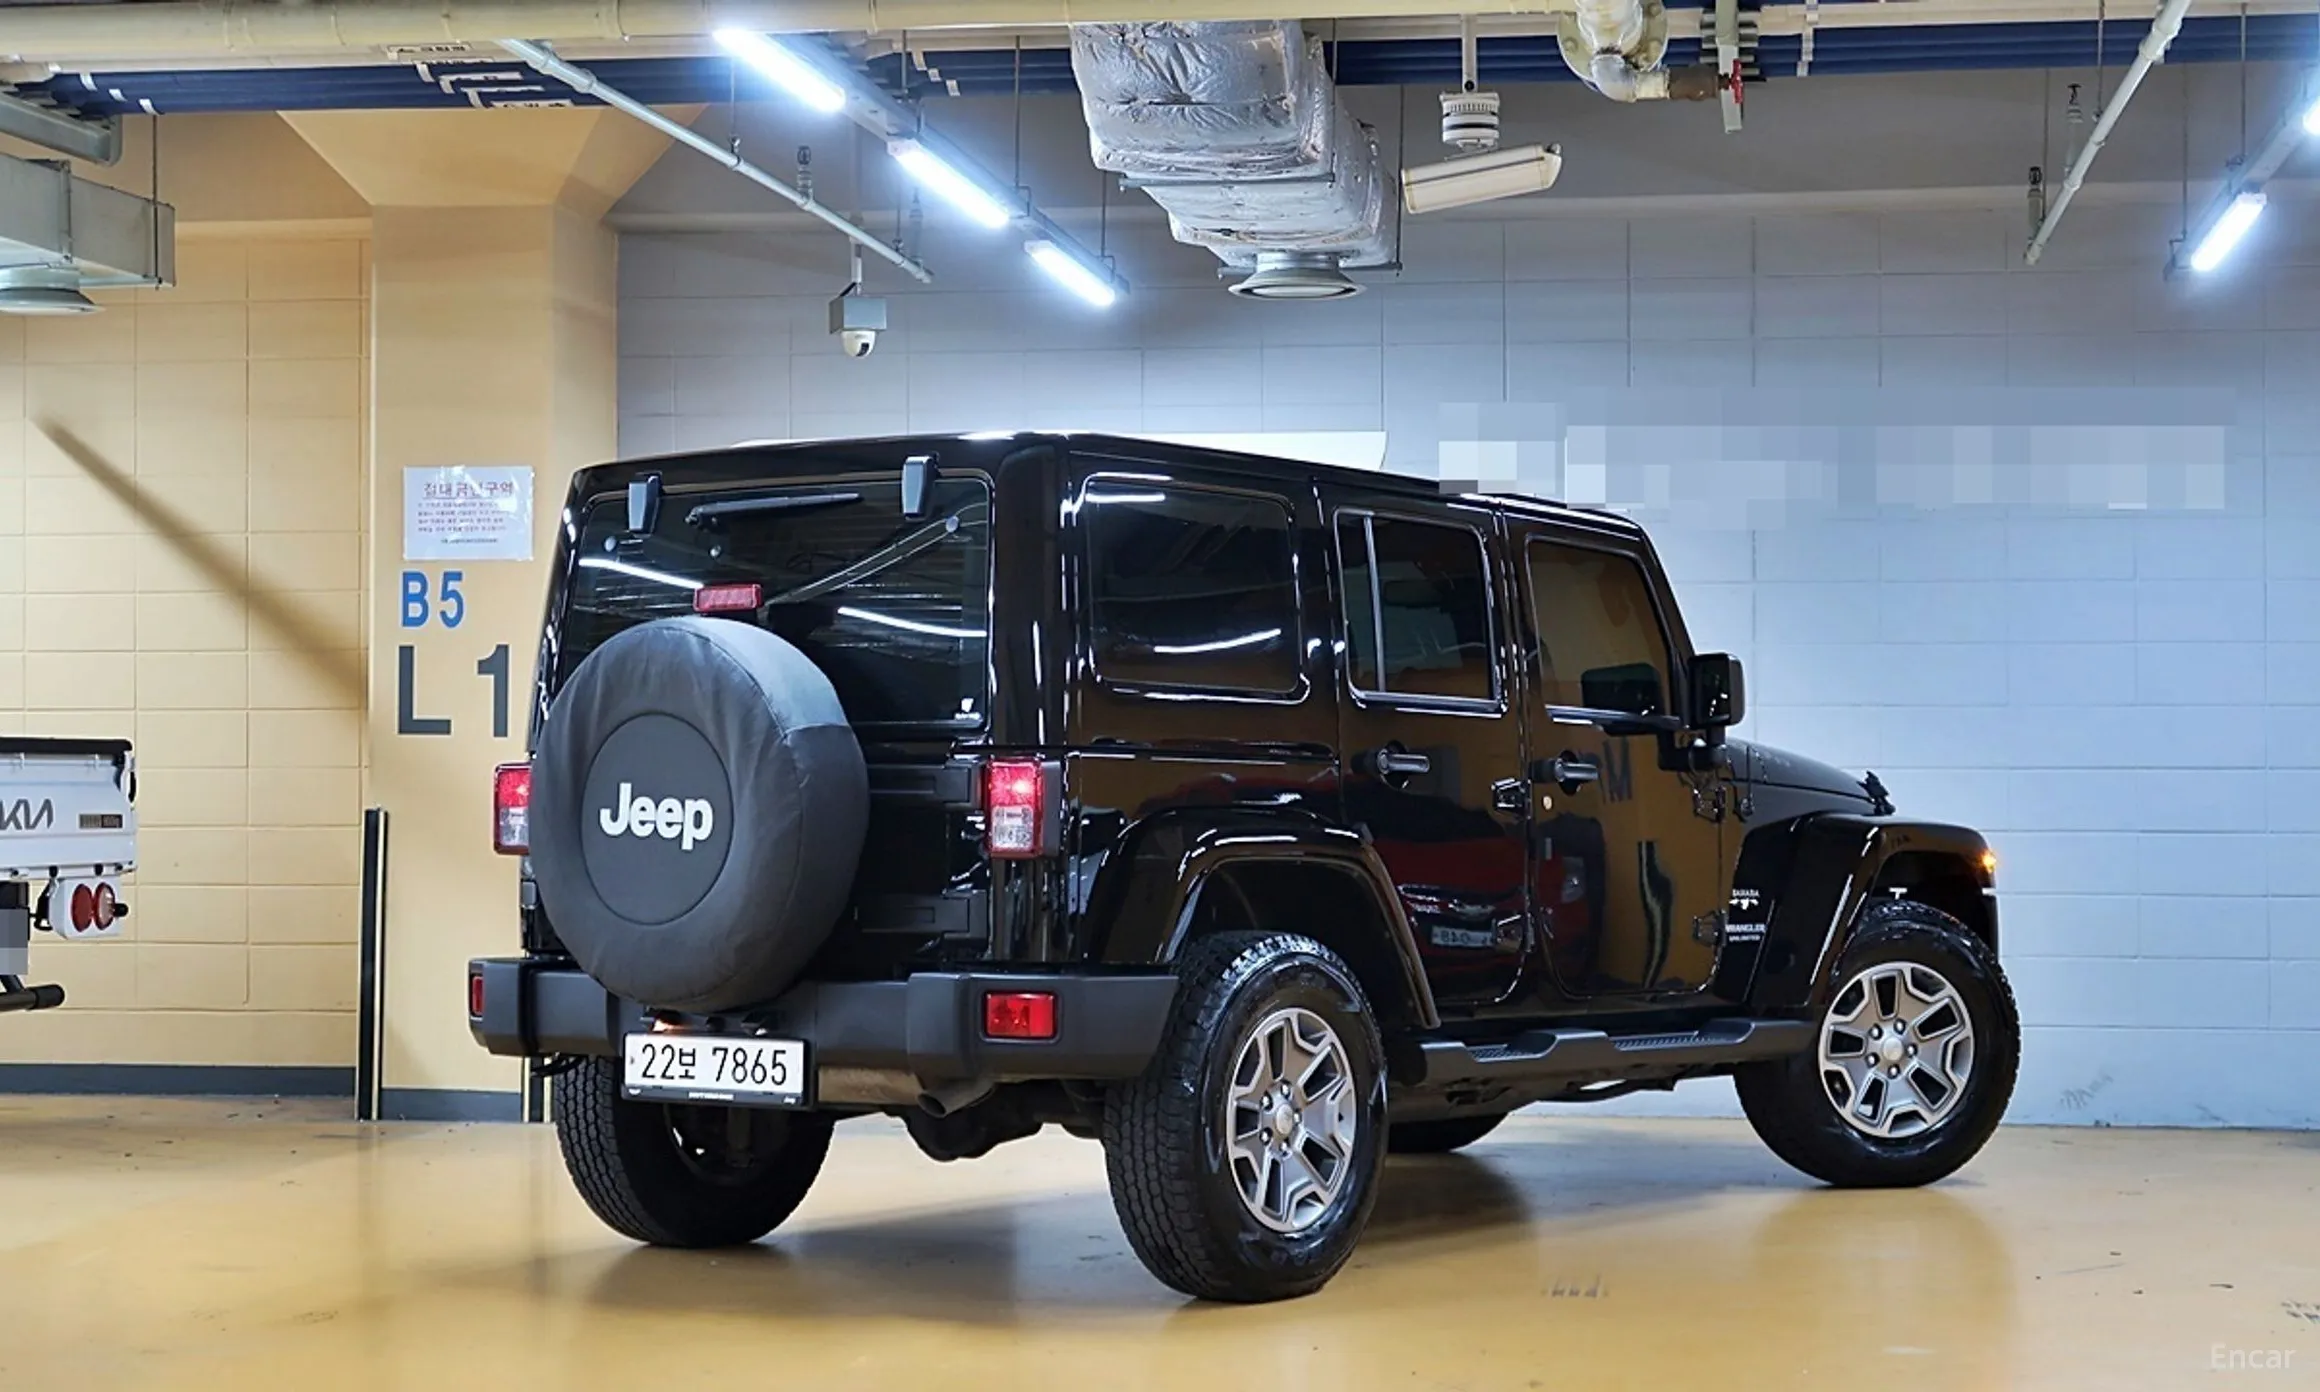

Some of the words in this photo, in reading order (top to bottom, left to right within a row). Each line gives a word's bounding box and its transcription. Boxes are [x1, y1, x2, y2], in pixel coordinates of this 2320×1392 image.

[402, 571, 464, 628] B5
[600, 782, 713, 850] Jeep
[641, 1044, 696, 1080] 22보
[711, 1047, 787, 1086] 7865
